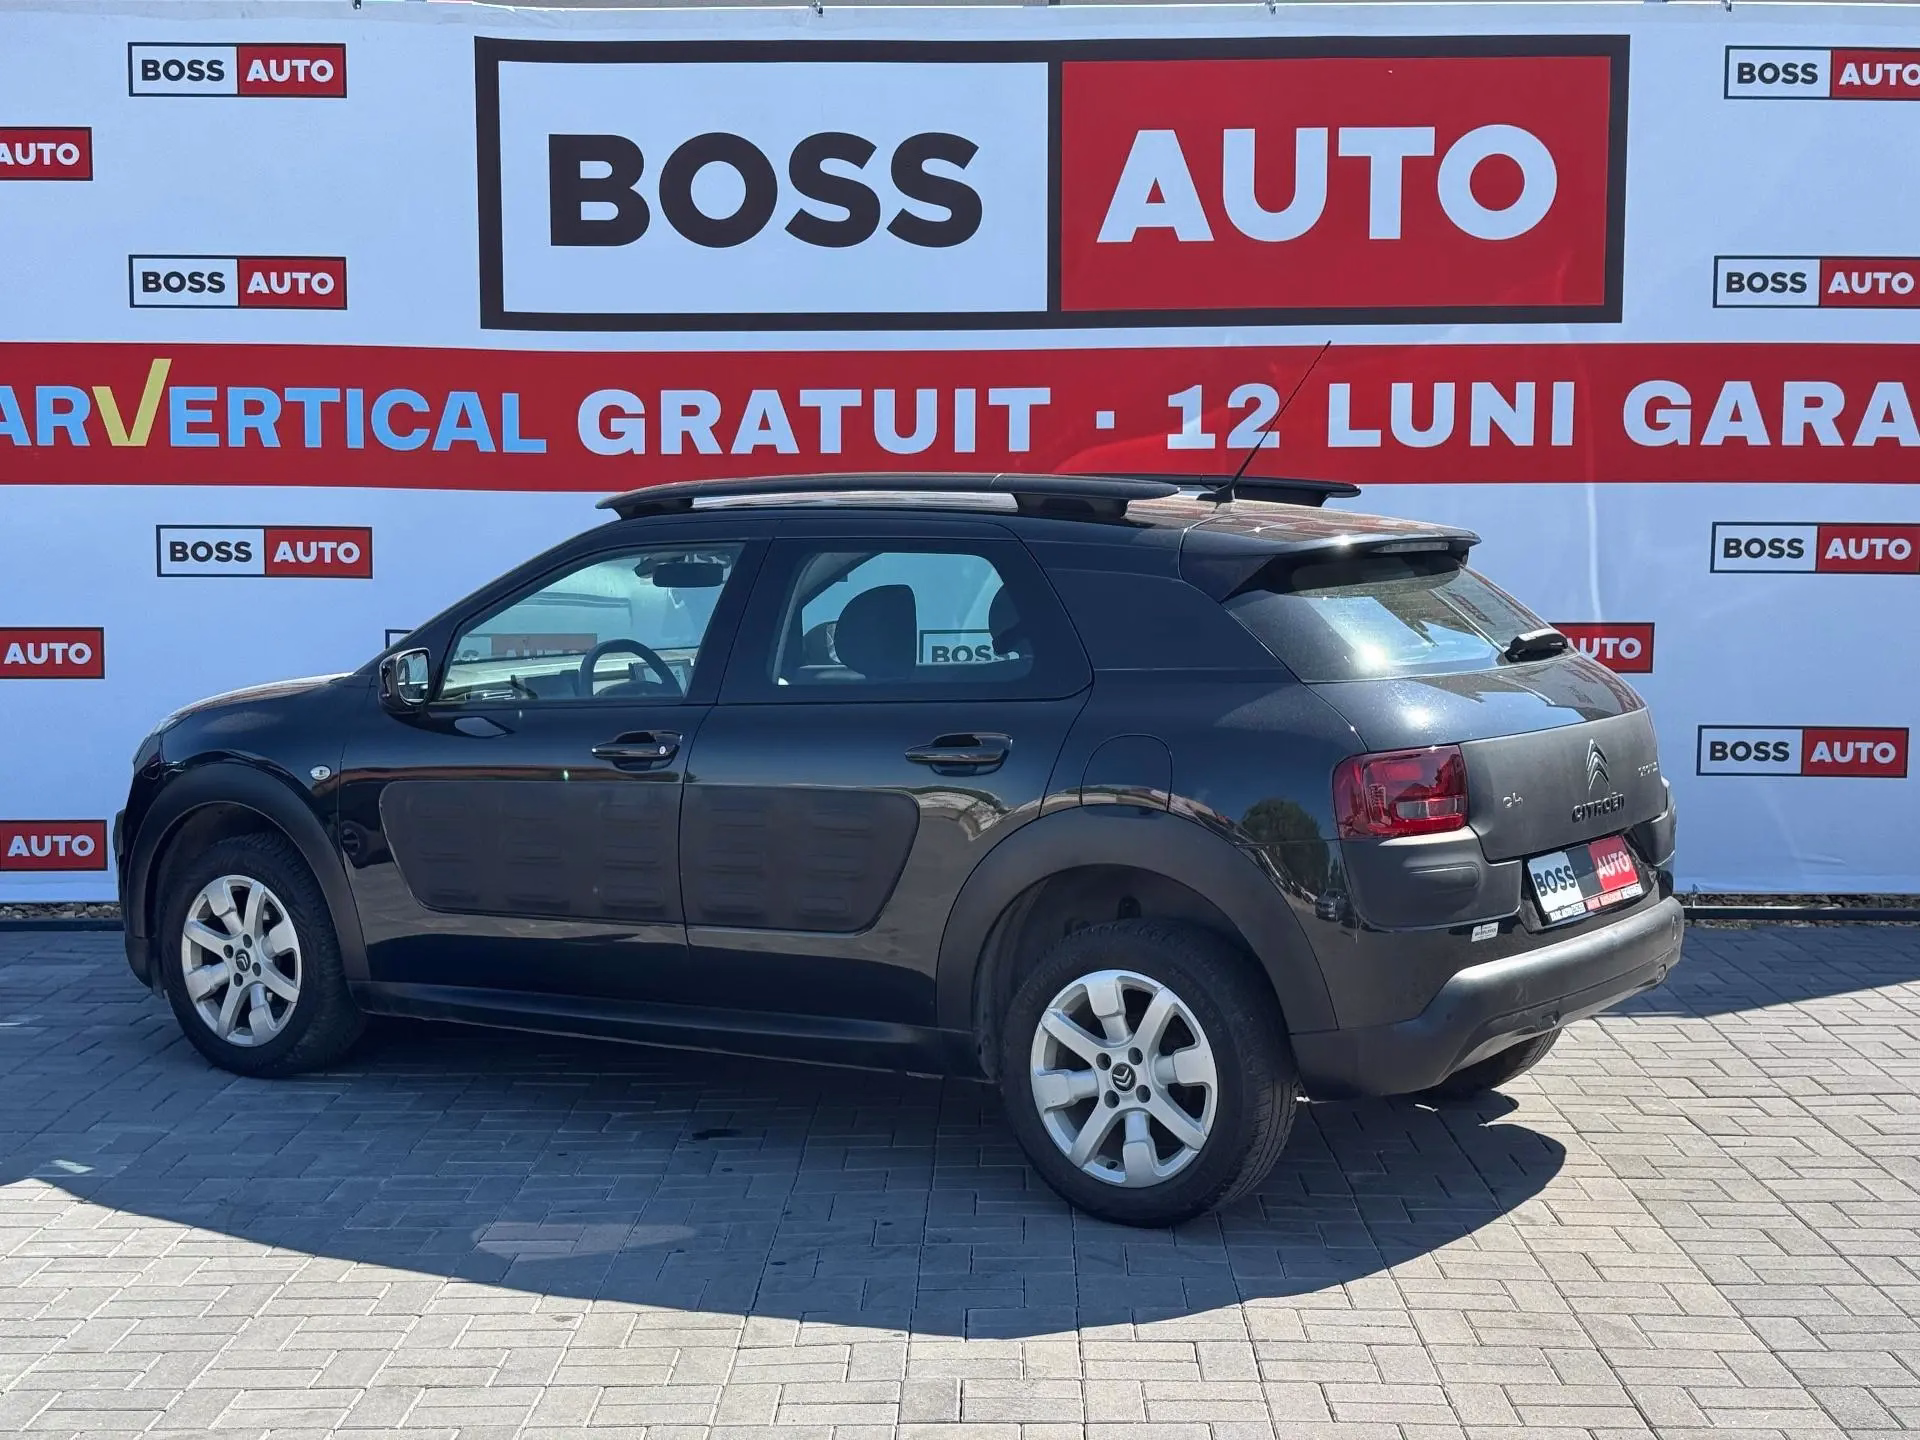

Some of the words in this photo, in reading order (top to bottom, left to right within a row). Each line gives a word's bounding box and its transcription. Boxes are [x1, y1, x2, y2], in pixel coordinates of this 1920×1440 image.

[141, 60, 225, 82] BOSS
[246, 60, 334, 83] AUTO
[1737, 62, 1818, 85] BOSS
[1838, 62, 1920, 87] AUTO
[0, 142, 80, 166] AUTO
[549, 132, 983, 248] BOSS
[1097, 124, 1558, 243] AUTO
[142, 271, 226, 294] BOSS
[246, 272, 335, 295] AUTO
[1725, 272, 1807, 294] BOSS
[1828, 272, 1915, 295] AUTO
[577, 387, 1051, 456] GRATUIT
[1167, 383, 1281, 450] 12
[1327, 381, 1575, 448] LUNI
[1623, 380, 1920, 447] GARA
[169, 540, 253, 563] BOSS
[273, 541, 361, 564] AUTO
[1723, 537, 1805, 559] BOSS
[1824, 538, 1912, 560] AUTO
[4, 642, 92, 665] AUTO
[931, 645, 1010, 663] BOS
[1709, 740, 1790, 762] BOSS
[1810, 741, 1896, 764] AUTO
[7, 834, 95, 857] AUTO
[1533, 864, 1577, 897] BOSS
[1596, 850, 1631, 880] AUTO
